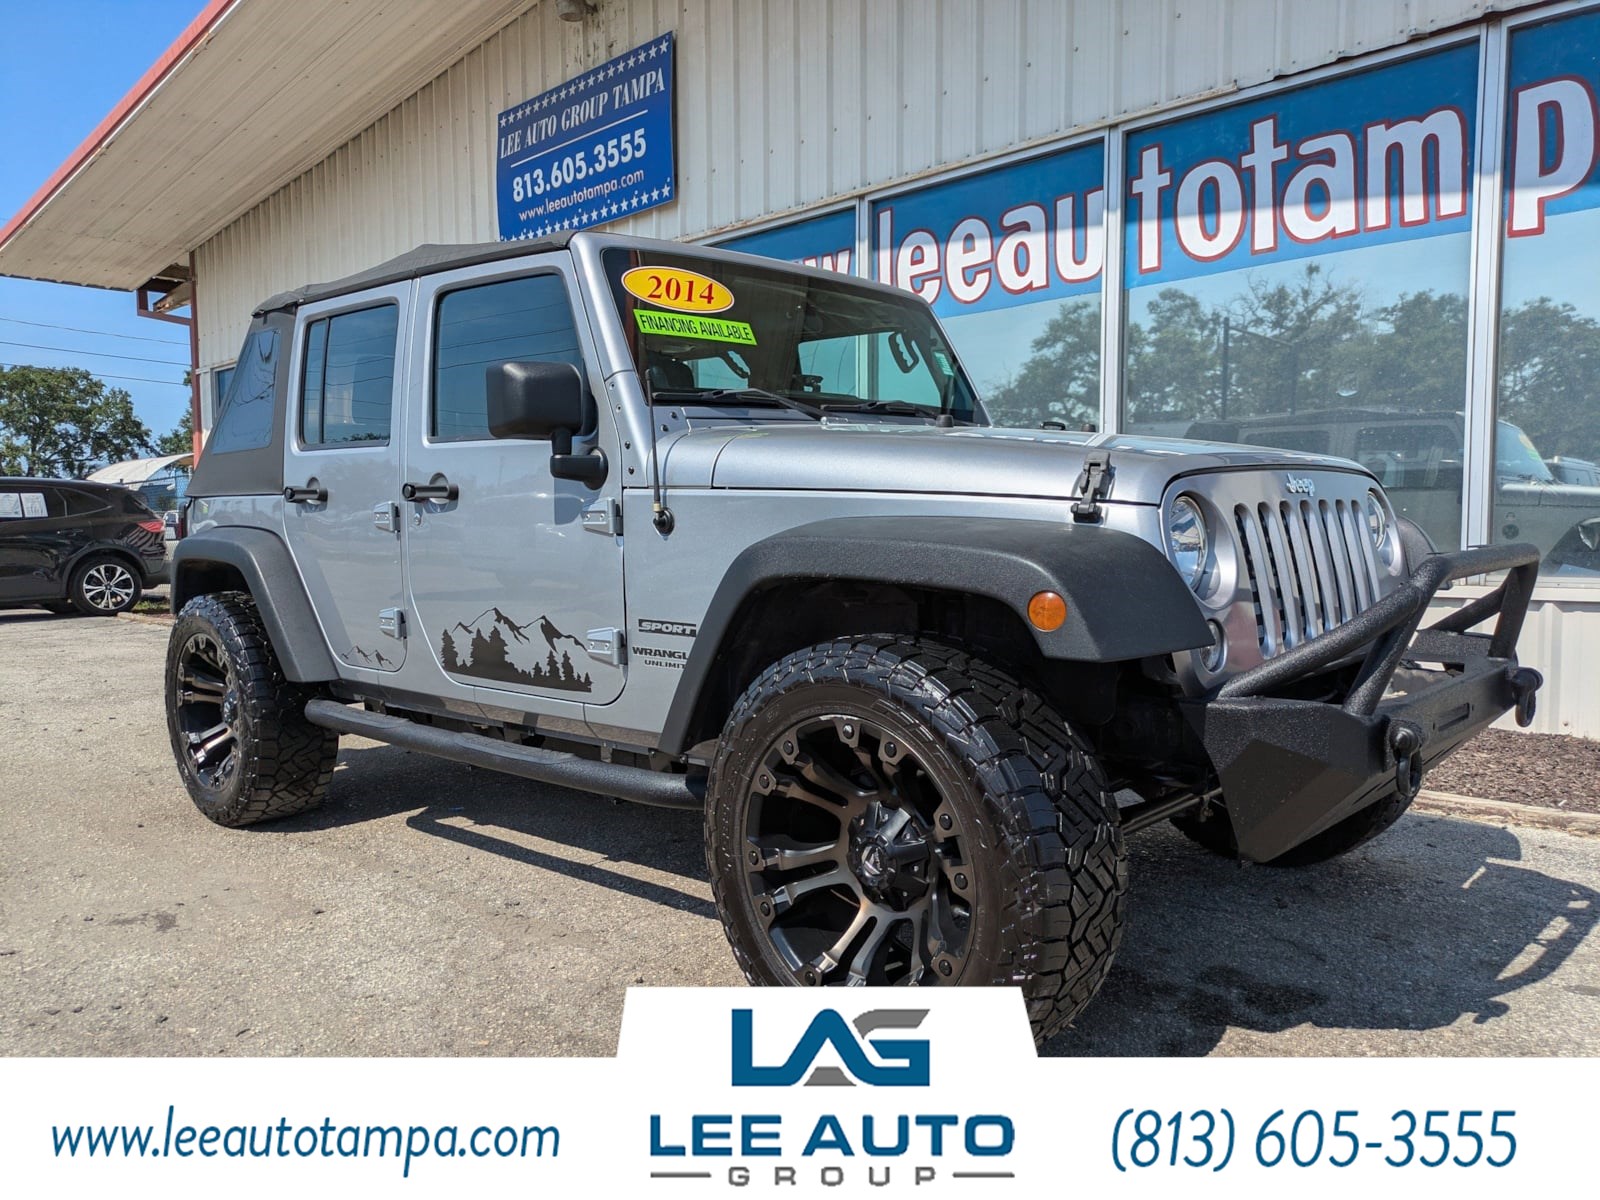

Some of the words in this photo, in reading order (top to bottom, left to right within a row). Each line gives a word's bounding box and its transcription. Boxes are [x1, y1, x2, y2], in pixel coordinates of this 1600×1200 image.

[500, 130, 521, 159] LEE
[525, 116, 557, 147] AUTO
[561, 92, 609, 132] GROUP
[612, 67, 665, 110] TAMPA
[512, 127, 647, 203] 813.605.3555
[518, 169, 645, 222] www.leeautotampa.com
[647, 275, 715, 305] 2014
[639, 314, 698, 335] FINANCING
[699, 320, 752, 341] AVAILABLE
[1286, 472, 1316, 497] Jeep
[640, 620, 697, 635] SPORT
[632, 646, 689, 660] WRANGL
[644, 659, 686, 670] UNLIMIT
